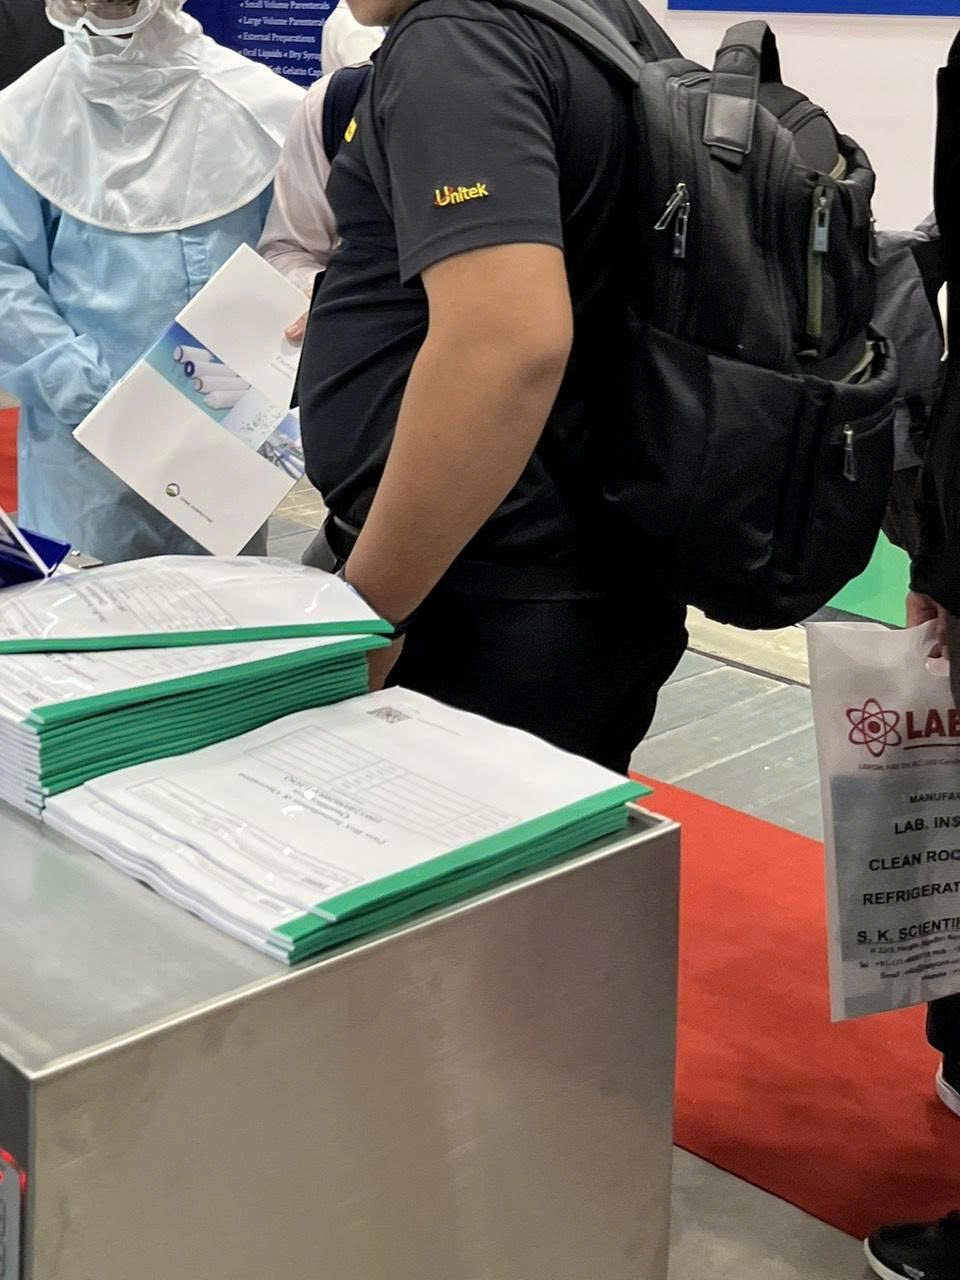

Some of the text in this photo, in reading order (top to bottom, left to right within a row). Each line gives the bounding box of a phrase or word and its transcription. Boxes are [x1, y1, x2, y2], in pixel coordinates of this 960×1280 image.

[435, 182, 489, 207] Unitek
[894, 818, 929, 835] LAB.
[868, 853, 922, 872] CLEAN
[857, 930, 872, 945] S.
[877, 929, 894, 943] K.
